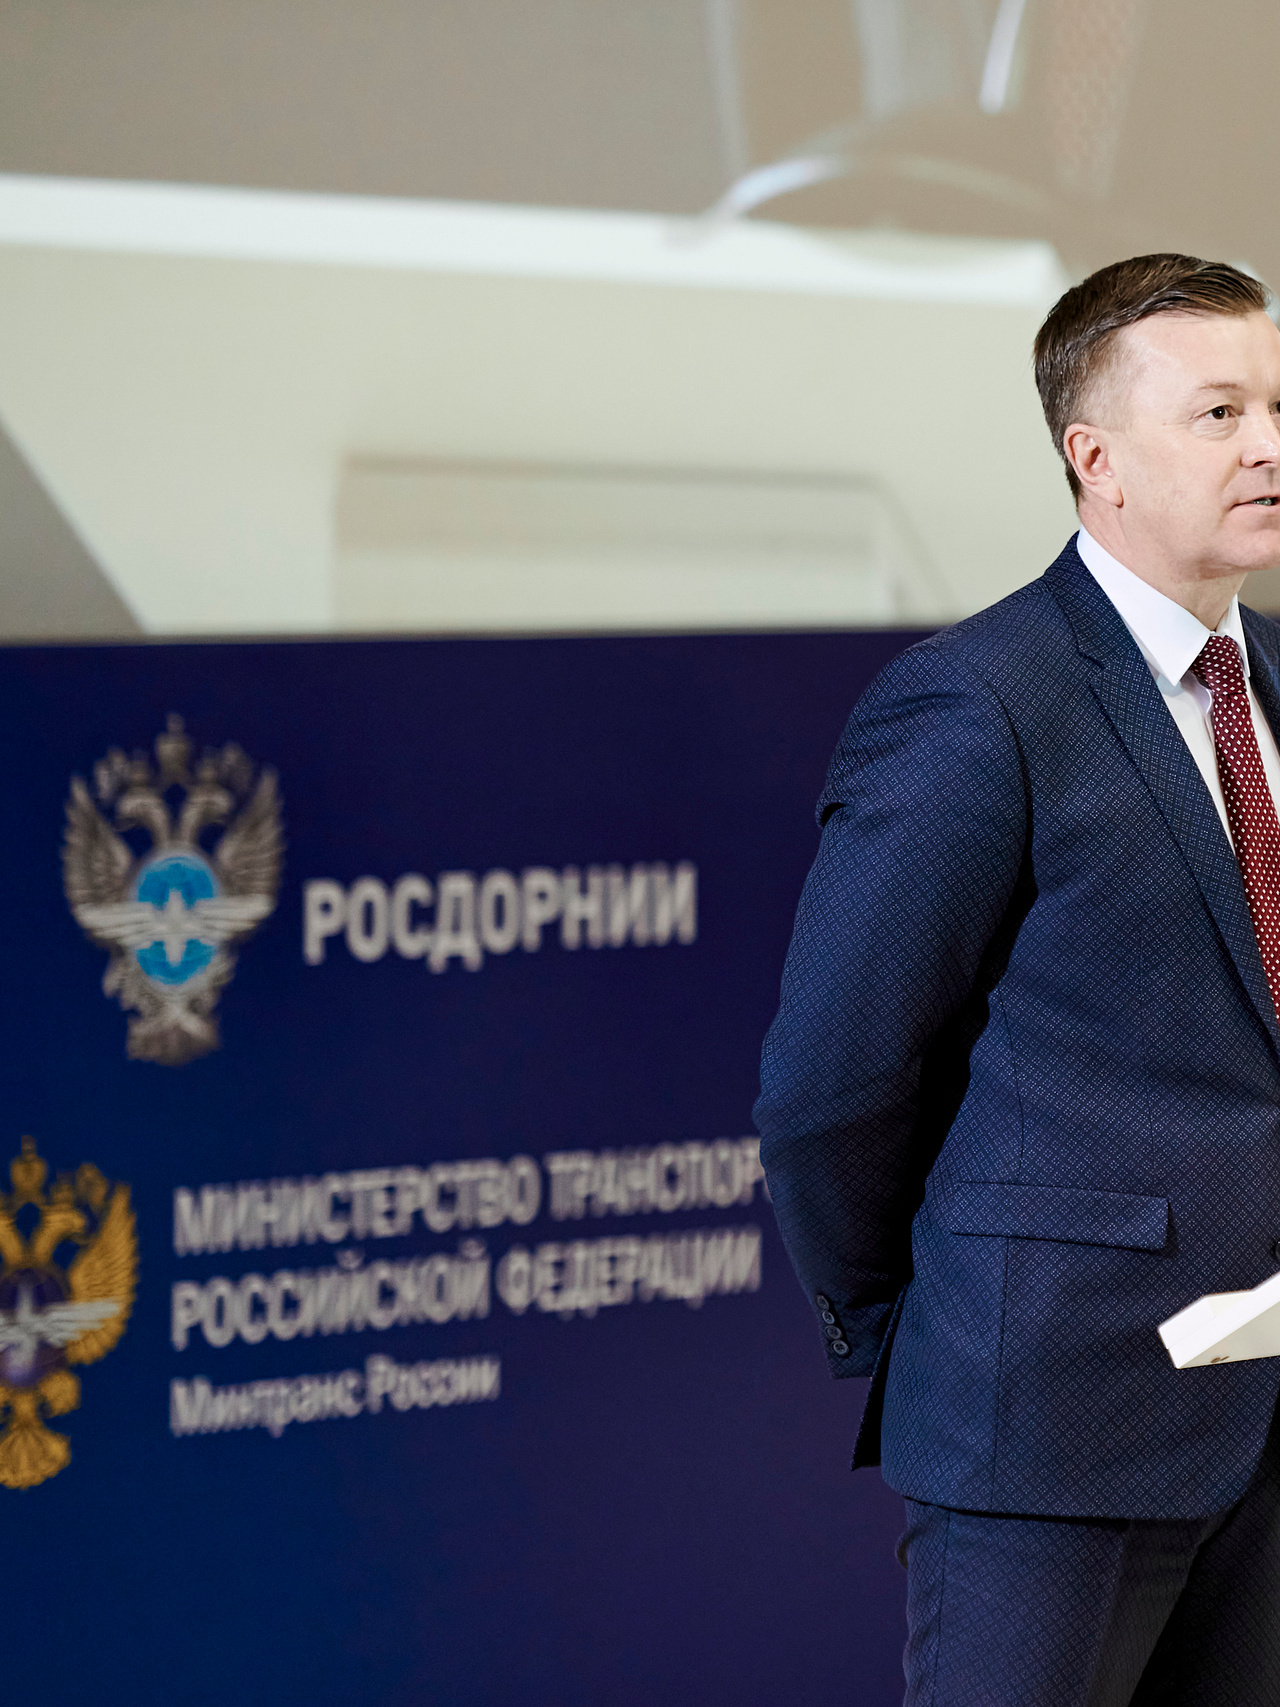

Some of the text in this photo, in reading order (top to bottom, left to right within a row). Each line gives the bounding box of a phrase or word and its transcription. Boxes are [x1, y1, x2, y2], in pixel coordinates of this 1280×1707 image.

[303, 861, 697, 972] РОСДОРНИИ
[174, 1136, 767, 1255] МИНИСТЕРСТВО ТРАНСПОР
[172, 1225, 762, 1350] РОССИЙСКОЙ ФЕДЕРАЦИИ
[171, 1353, 501, 1438] Минтранс России
